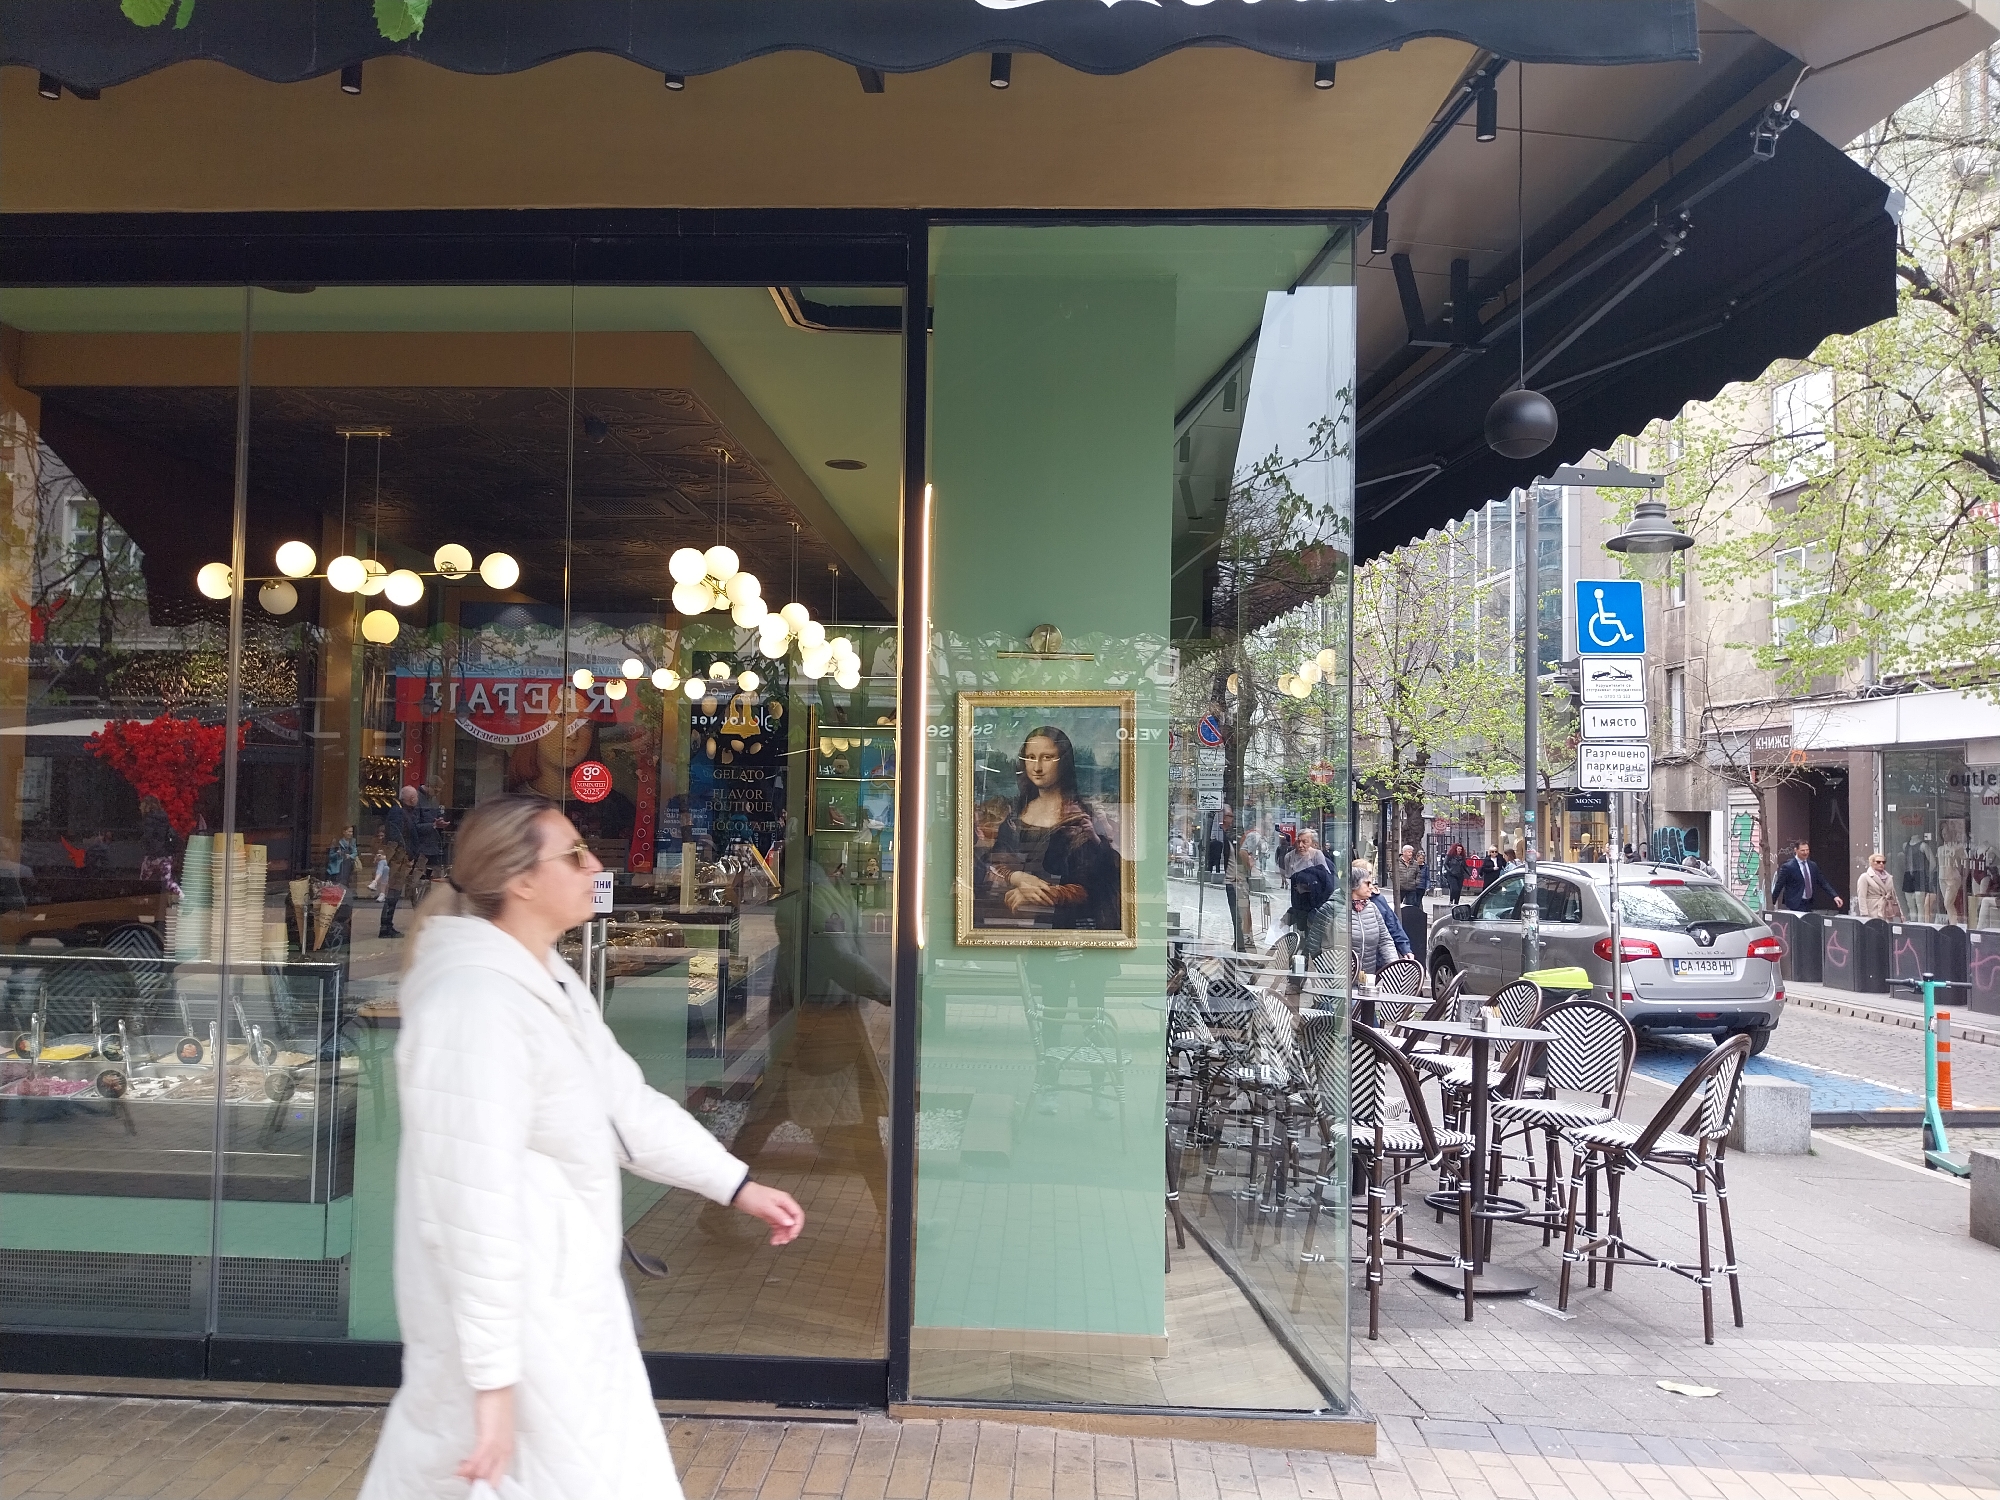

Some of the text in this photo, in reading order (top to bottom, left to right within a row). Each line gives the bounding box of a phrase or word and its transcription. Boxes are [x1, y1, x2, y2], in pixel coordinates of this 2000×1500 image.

[582, 767, 600, 781] go
[712, 769, 765, 780] GELATO
[1949, 770, 2000, 787] outle
[712, 788, 764, 800] FLAVOR
[705, 801, 773, 815] BOUTIQUE
[704, 820, 777, 832] HOCOLATE
[1696, 960, 1718, 971] 1438
